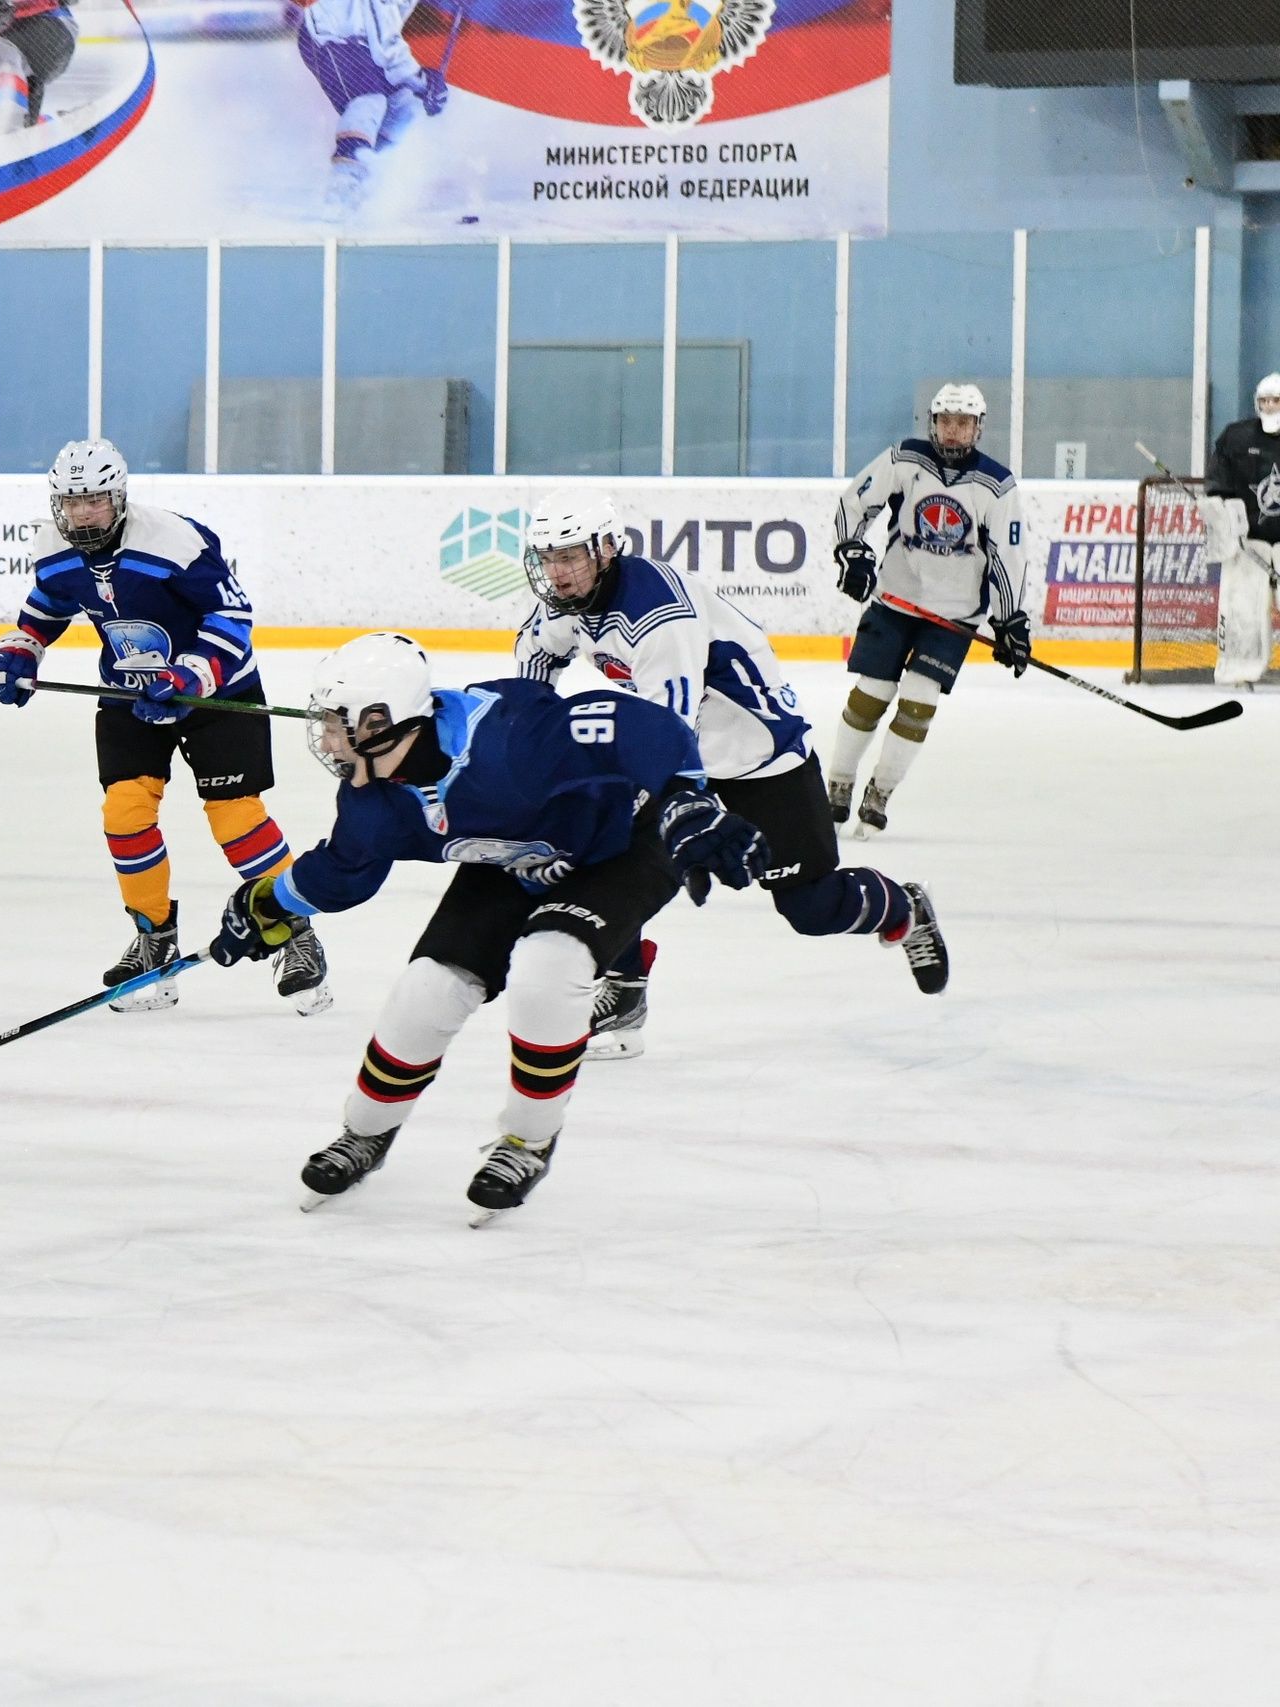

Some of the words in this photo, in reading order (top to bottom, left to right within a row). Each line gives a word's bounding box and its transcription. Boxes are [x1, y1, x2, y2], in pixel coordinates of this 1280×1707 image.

[546, 145, 708, 166] МИНИСТЕРСТВО
[719, 143, 798, 162] СПОРТА
[533, 175, 669, 200] РОССИЙСКОЙ
[680, 177, 810, 201] ФЕДЕРАЦИИ
[70, 464, 85, 474] 99
[1009, 521, 1021, 545] 8
[716, 582, 807, 597] КОМПАНИЙ
[664, 676, 689, 716] 11
[569, 700, 617, 744] 96
[198, 773, 245, 787] CCM
[758, 862, 801, 881] CM
